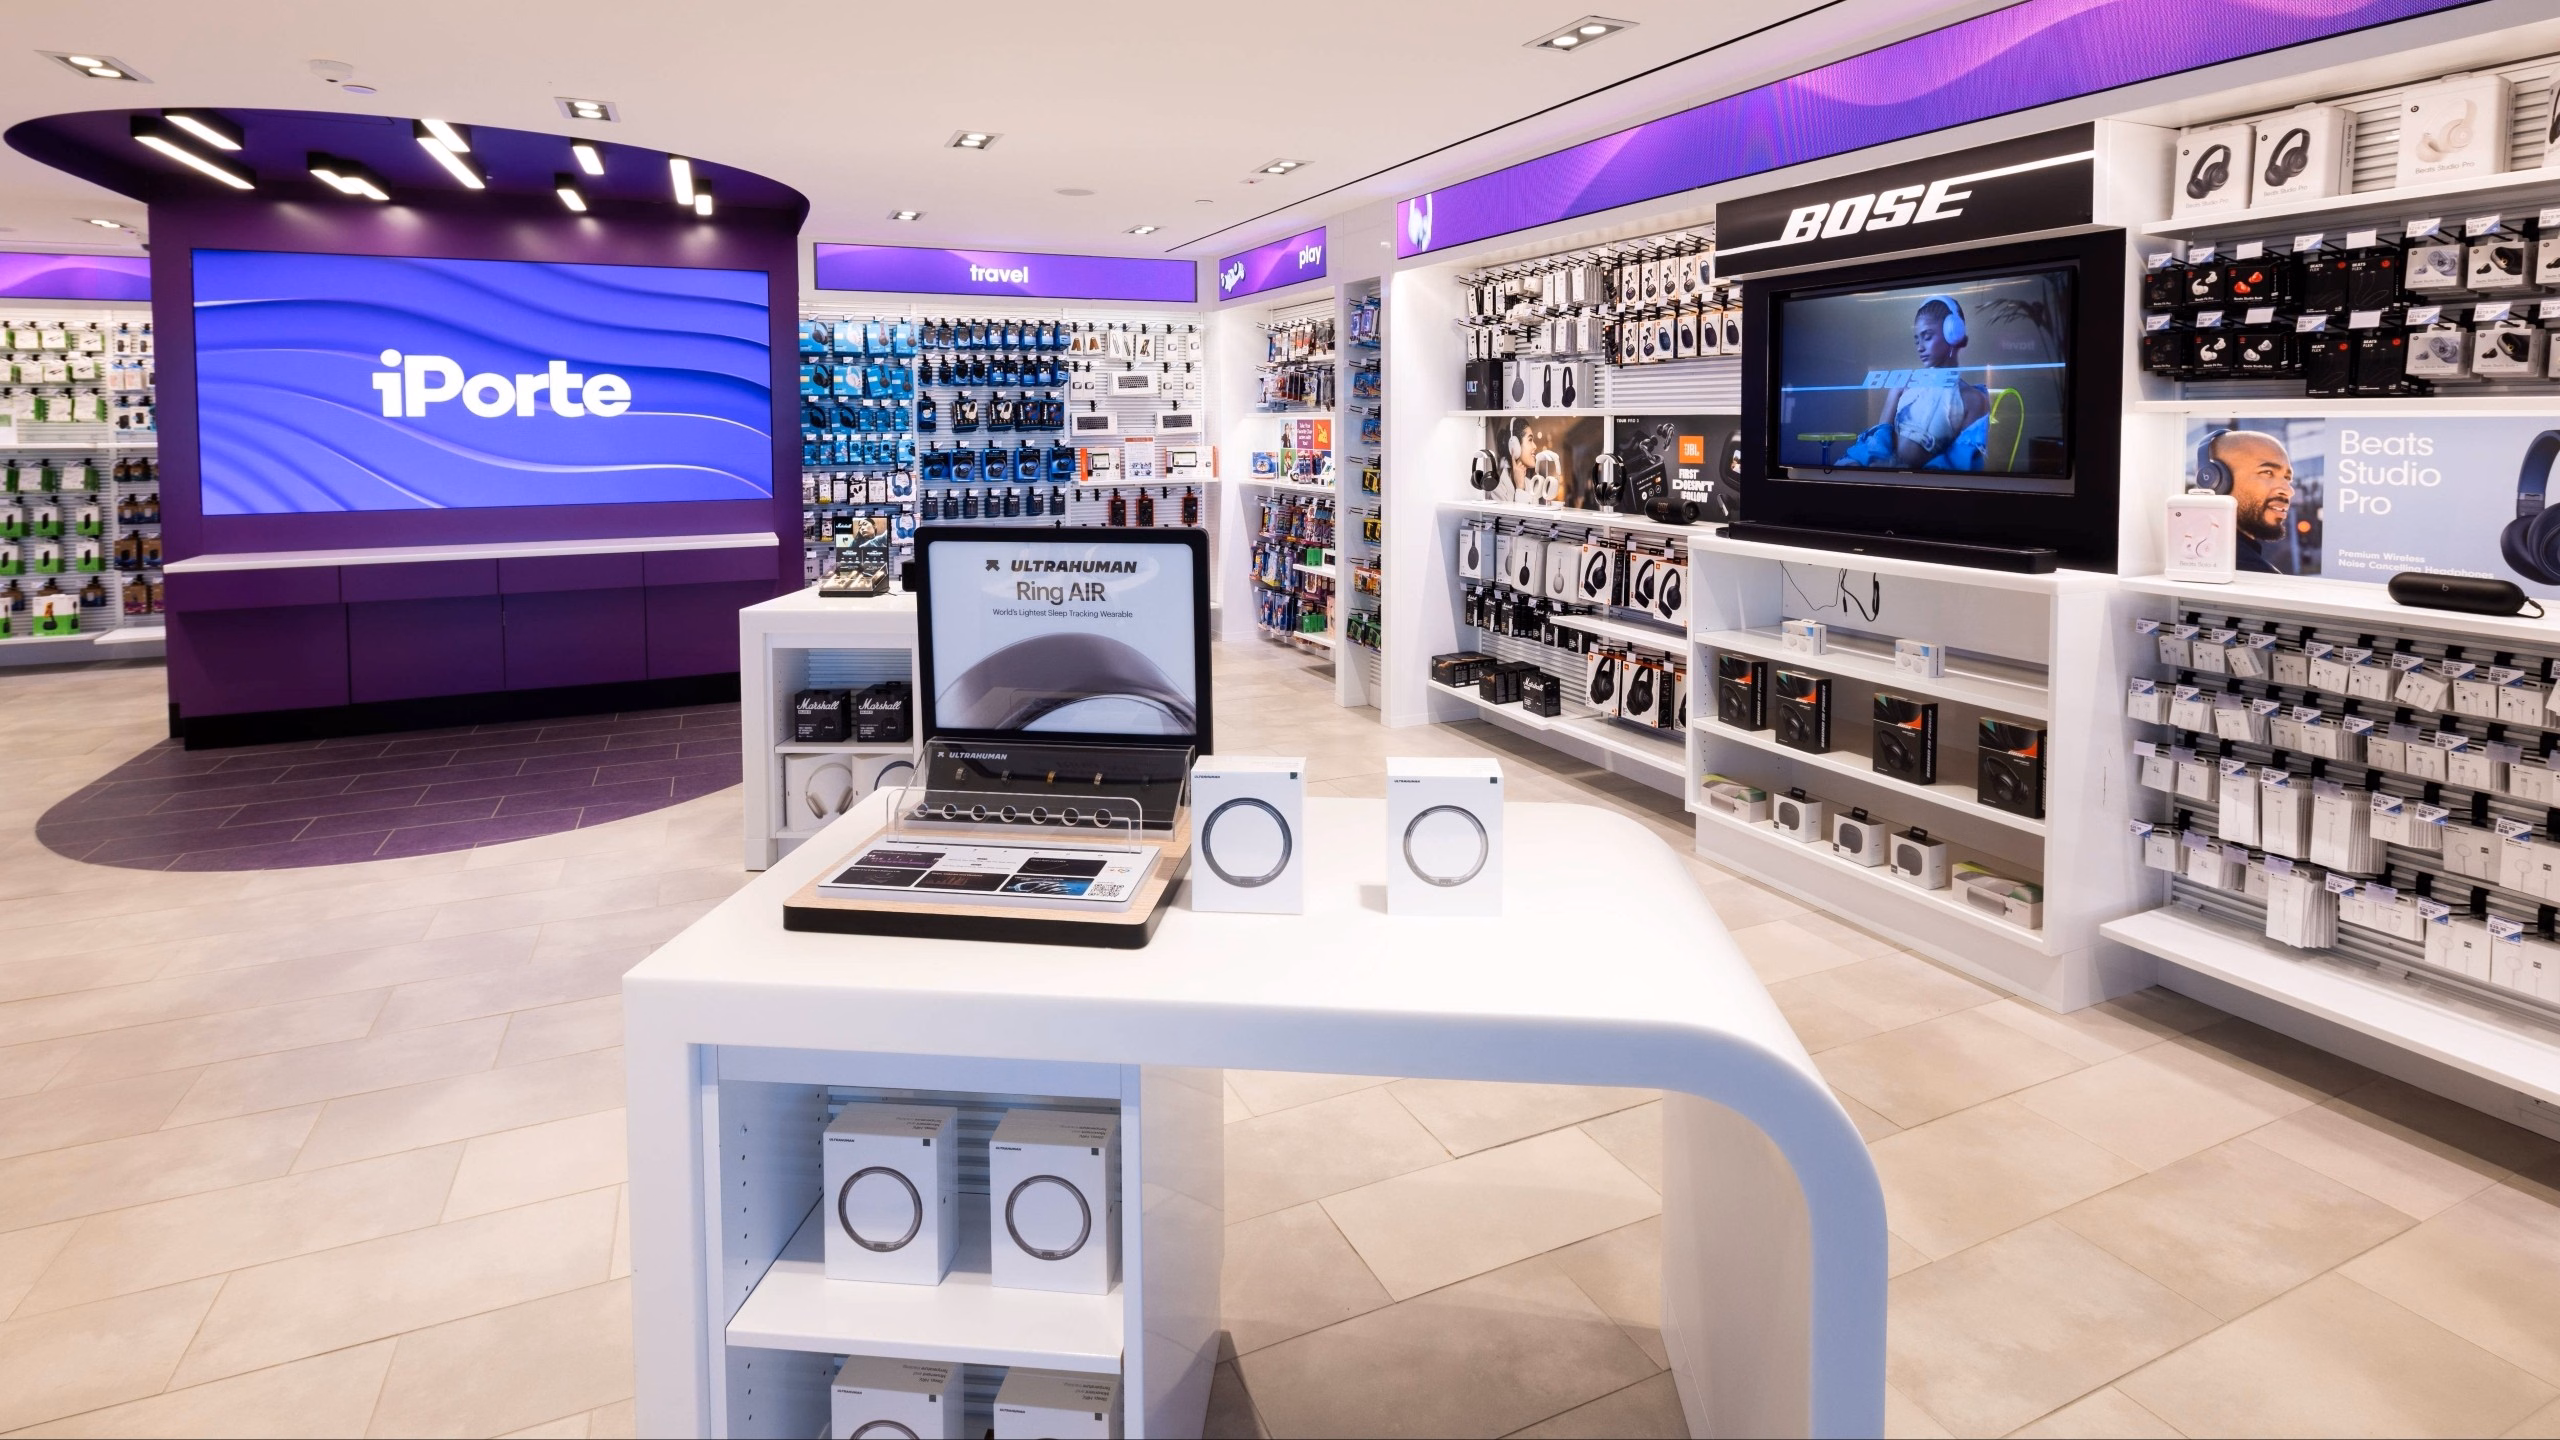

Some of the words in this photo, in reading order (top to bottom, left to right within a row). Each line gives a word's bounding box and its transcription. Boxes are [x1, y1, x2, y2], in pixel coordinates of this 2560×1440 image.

[2415, 167, 2436, 175] Beats
[2437, 163, 2460, 172] Studio
[2280, 187, 2297, 196] Studio
[1780, 182, 1972, 242] BOSE
[1299, 245, 1322, 269] play
[970, 264, 1028, 283] travel
[372, 349, 632, 418] iPorte
[1862, 368, 1960, 388] BOSE
[1467, 381, 1478, 393] ULT
[2341, 429, 2434, 456] Beats
[1684, 443, 1700, 456] JBL
[1679, 468, 1700, 480] FIRST
[2338, 458, 2441, 487] Studio
[1681, 491, 1708, 503] FOLLOW
[2339, 488, 2392, 515] Pro
[2338, 549, 2380, 560] Premium
[2383, 552, 2426, 563] Wireless
[1011, 560, 1137, 573] ULTRAHUMAN
[2338, 558, 2366, 568] Noise
[1016, 580, 1064, 606] Ring
[1068, 582, 1106, 602] AIR
[992, 608, 1018, 617] World's
[1019, 609, 1046, 618] Lightest
[1048, 609, 1068, 618] Sleep
[1069, 609, 1099, 619] Tracking
[1100, 610, 1133, 618] Wearable
[1523, 677, 1544, 691] Marshall
[797, 697, 840, 710] Marshall
[858, 697, 902, 710] Marshall
[1821, 713, 1826, 721] IS
[1927, 740, 1932, 749] IS
[949, 752, 1008, 760] ULTRAHUMAN
